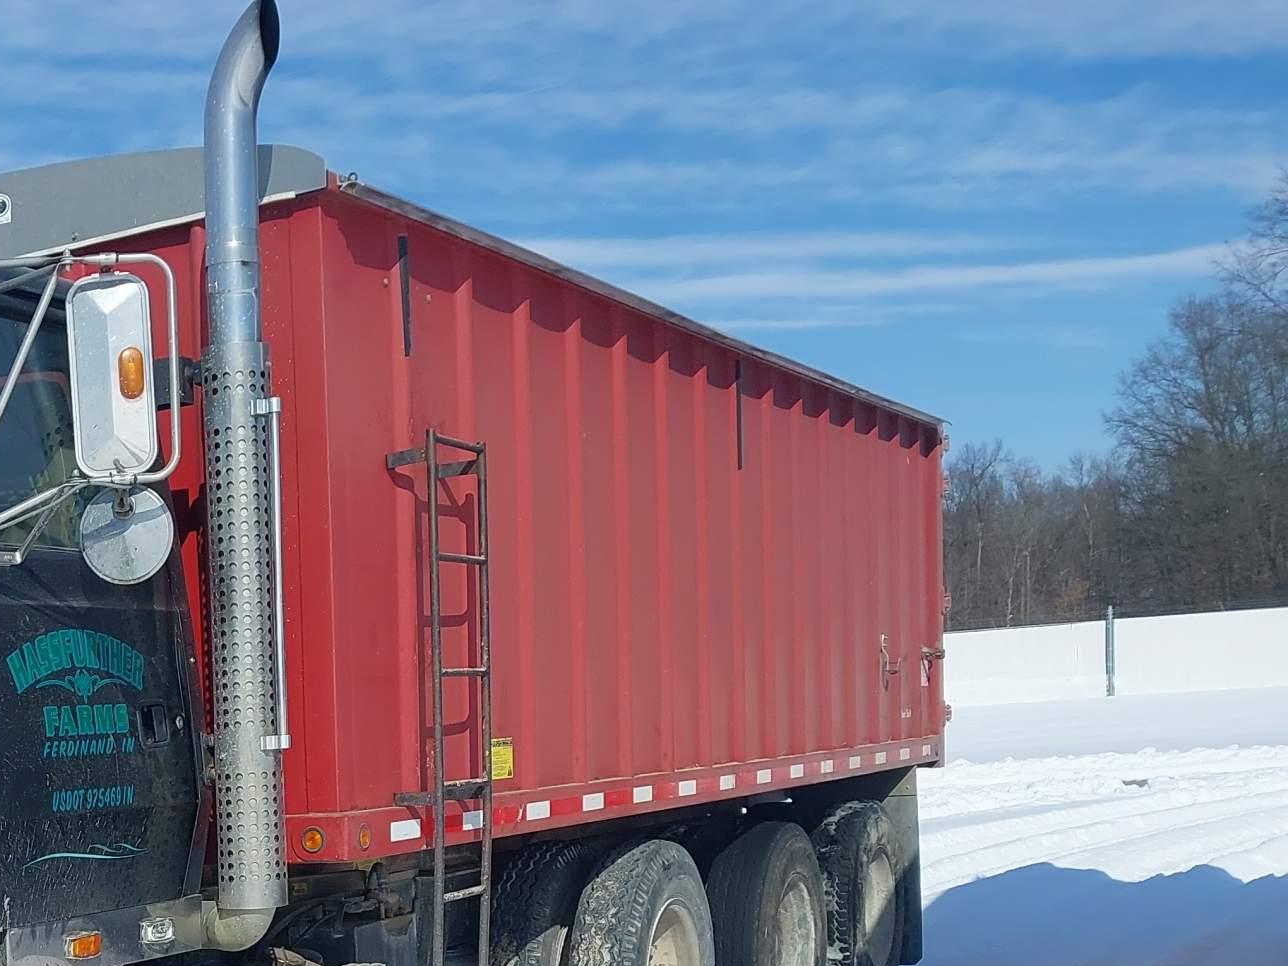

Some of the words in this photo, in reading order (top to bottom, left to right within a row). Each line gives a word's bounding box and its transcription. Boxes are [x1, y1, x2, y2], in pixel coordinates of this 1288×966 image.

[6, 628, 145, 694] HASSFURTHER
[43, 703, 130, 737] FARMS
[121, 736, 135, 753] IN
